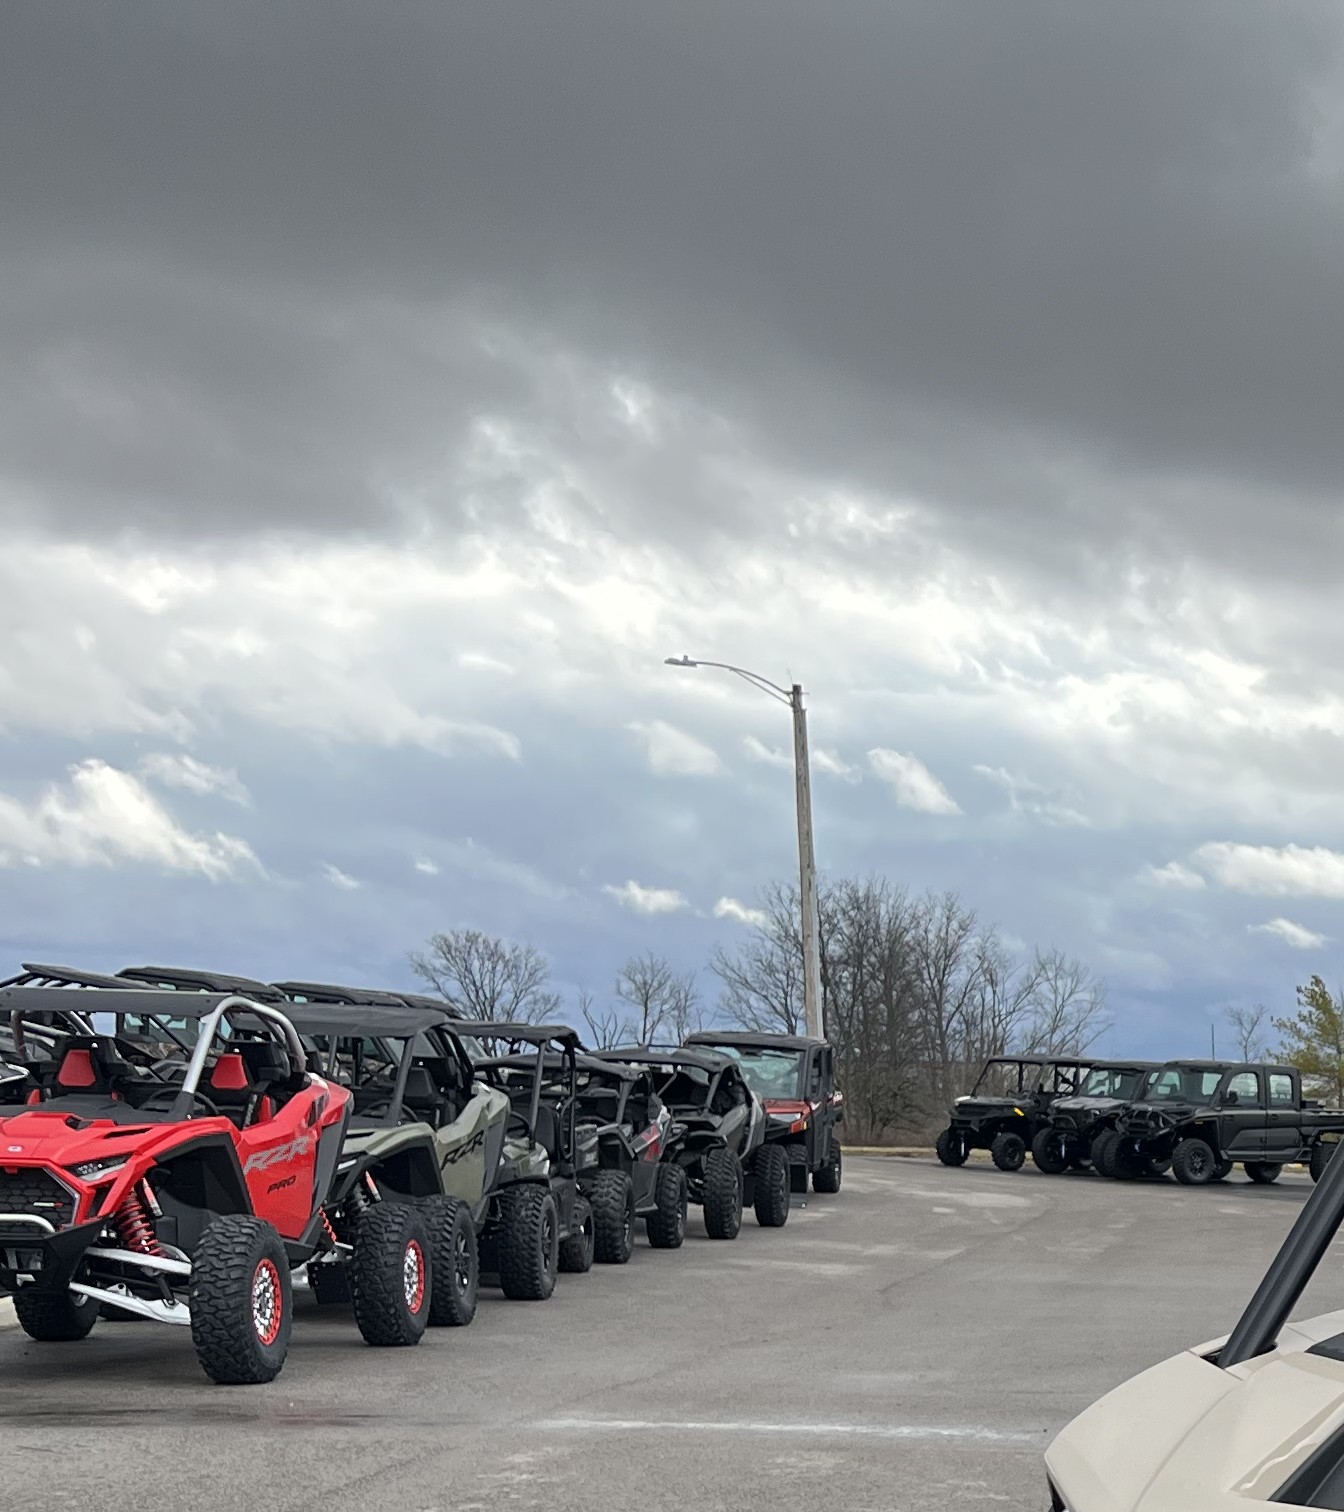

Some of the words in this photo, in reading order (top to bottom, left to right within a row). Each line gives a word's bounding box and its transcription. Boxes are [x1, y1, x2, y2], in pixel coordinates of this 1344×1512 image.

[242, 1135, 310, 1177] RZR
[440, 1129, 485, 1171] RZR
[266, 1174, 297, 1195] PRO
